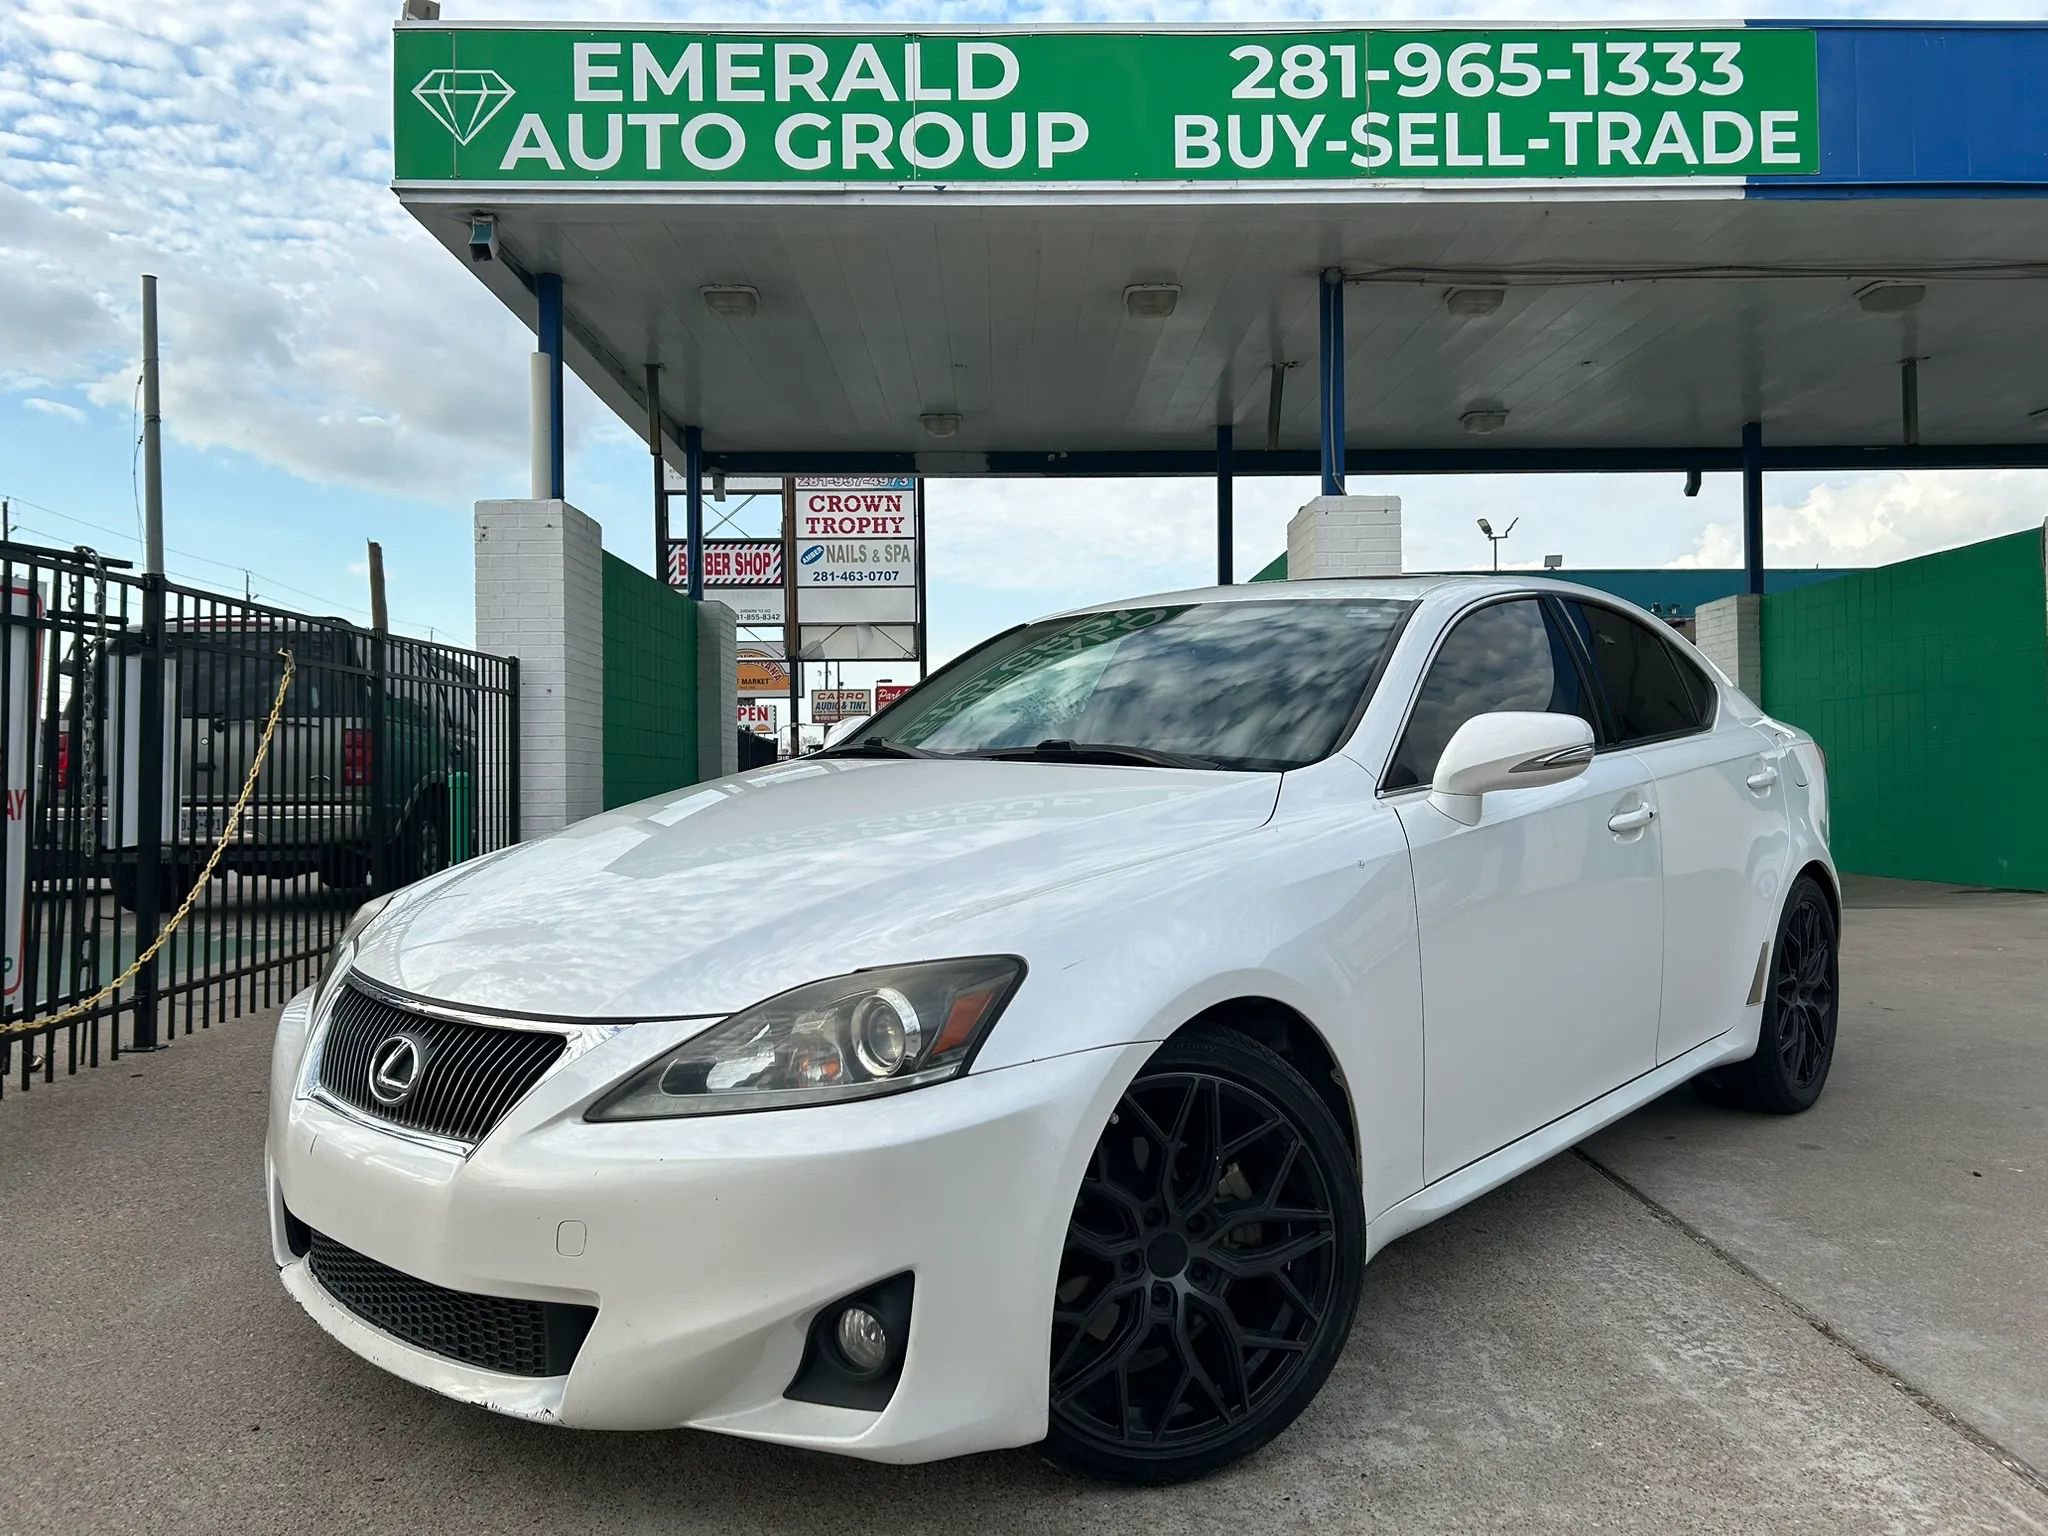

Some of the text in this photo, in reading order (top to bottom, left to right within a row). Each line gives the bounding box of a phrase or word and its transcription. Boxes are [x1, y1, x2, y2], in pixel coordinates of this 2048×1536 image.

[573, 42, 1019, 102] EMERALD
[1229, 41, 1744, 99] 281-965-1333
[499, 111, 1089, 171] AUTO GROUP
[1174, 110, 1800, 169] BUY-SELL-TRADE
[808, 495, 903, 513] CROWN
[805, 517, 905, 534] TROPHY
[826, 544, 911, 563] NAILS & SPA
[678, 552, 771, 576] BBER SHOP
[812, 571, 900, 582] 281-463-0707
[736, 613, 780, 621] 81-855-8342
[817, 692, 865, 700] CARRO
[737, 707, 769, 721] PEN
[841, 701, 848, 710] &
[849, 701, 867, 710] TINT
